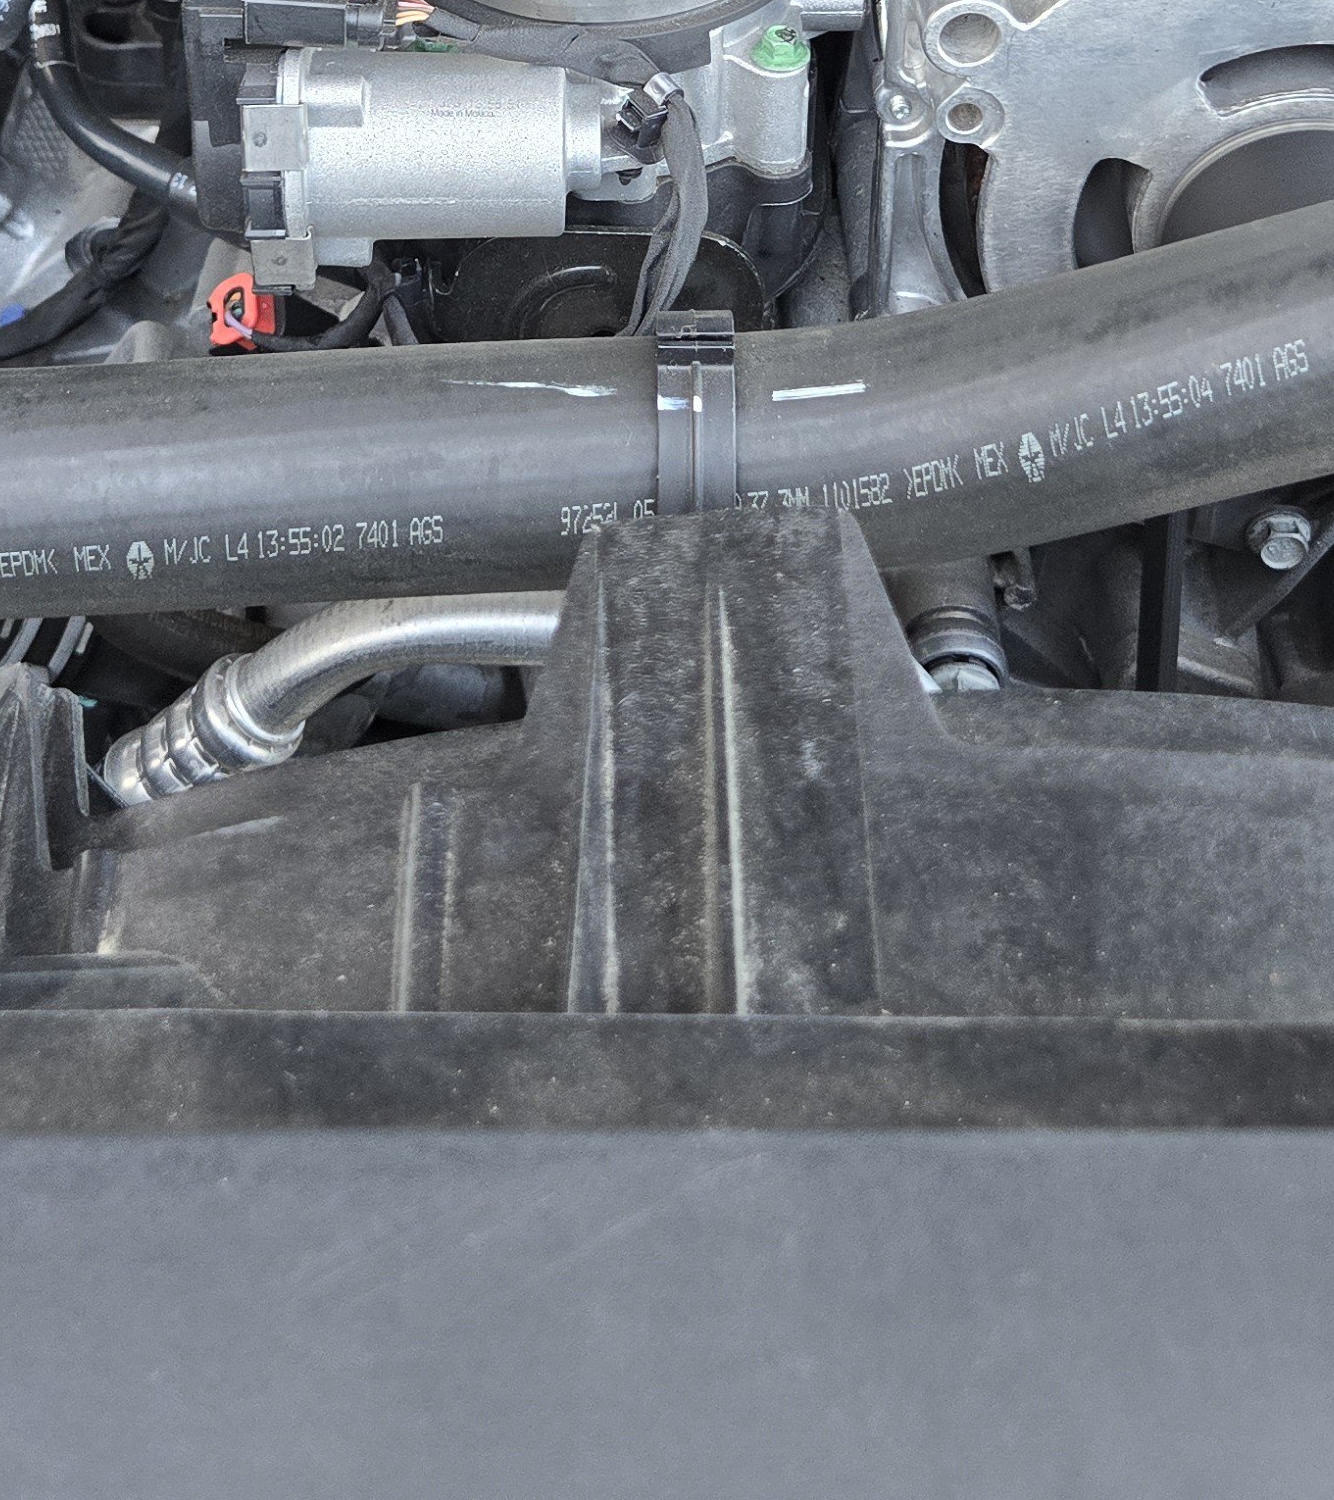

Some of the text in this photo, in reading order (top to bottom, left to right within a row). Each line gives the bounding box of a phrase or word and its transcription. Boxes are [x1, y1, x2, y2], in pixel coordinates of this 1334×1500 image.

[973, 440, 1010, 481] MEX
[1130, 373, 1214, 430] 13:55:04
[1219, 354, 1266, 397] 7401
[1272, 338, 1310, 382] AGS
[74, 544, 112, 573] MEX
[225, 532, 250, 562] L4
[257, 524, 346, 559] 13:55:02
[357, 520, 400, 550] 7401
[409, 514, 444, 545] AGS
